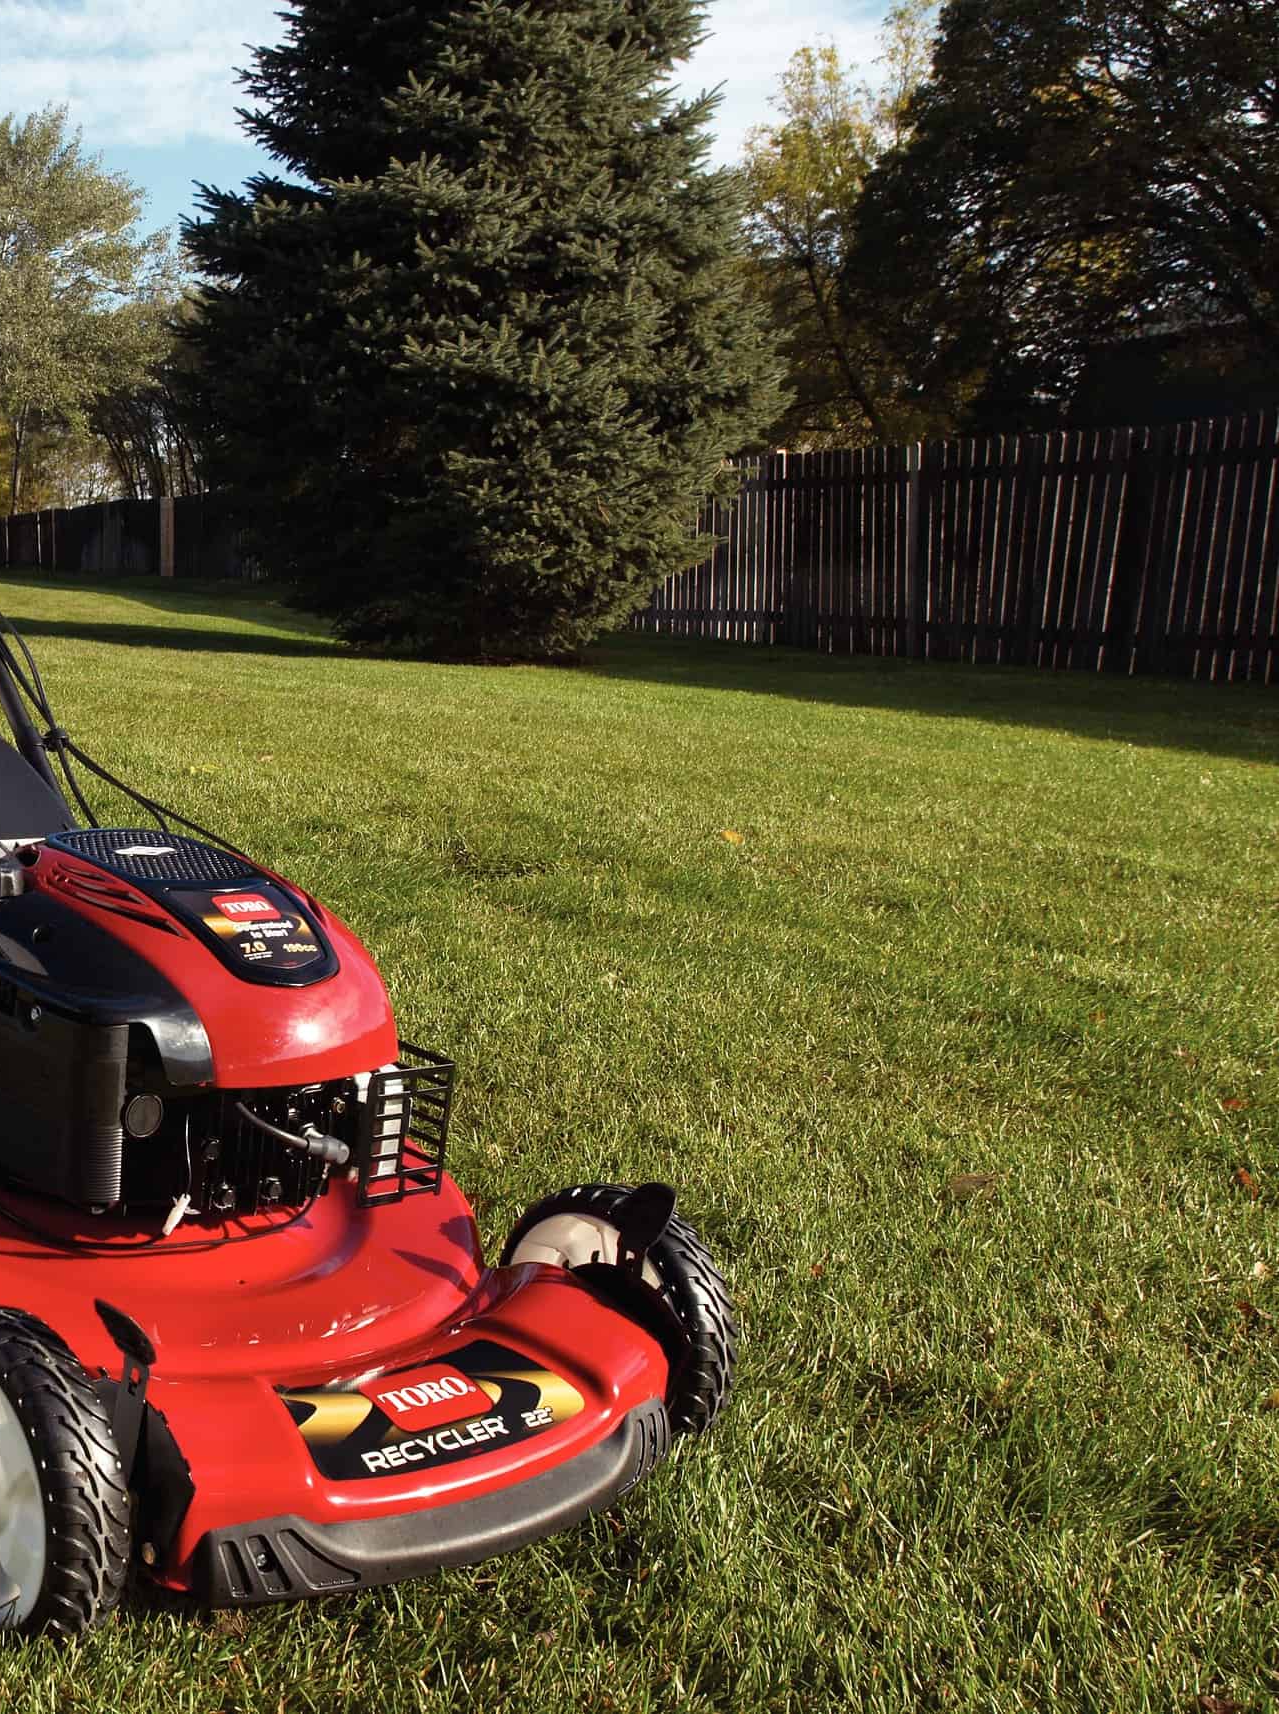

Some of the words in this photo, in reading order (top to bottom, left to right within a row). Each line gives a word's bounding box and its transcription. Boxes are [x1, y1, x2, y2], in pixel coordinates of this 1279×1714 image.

[221, 900, 271, 913] TORO
[240, 941, 266, 953] 7.0
[377, 1376, 470, 1413] TORO
[361, 1416, 510, 1473] RECYCLER
